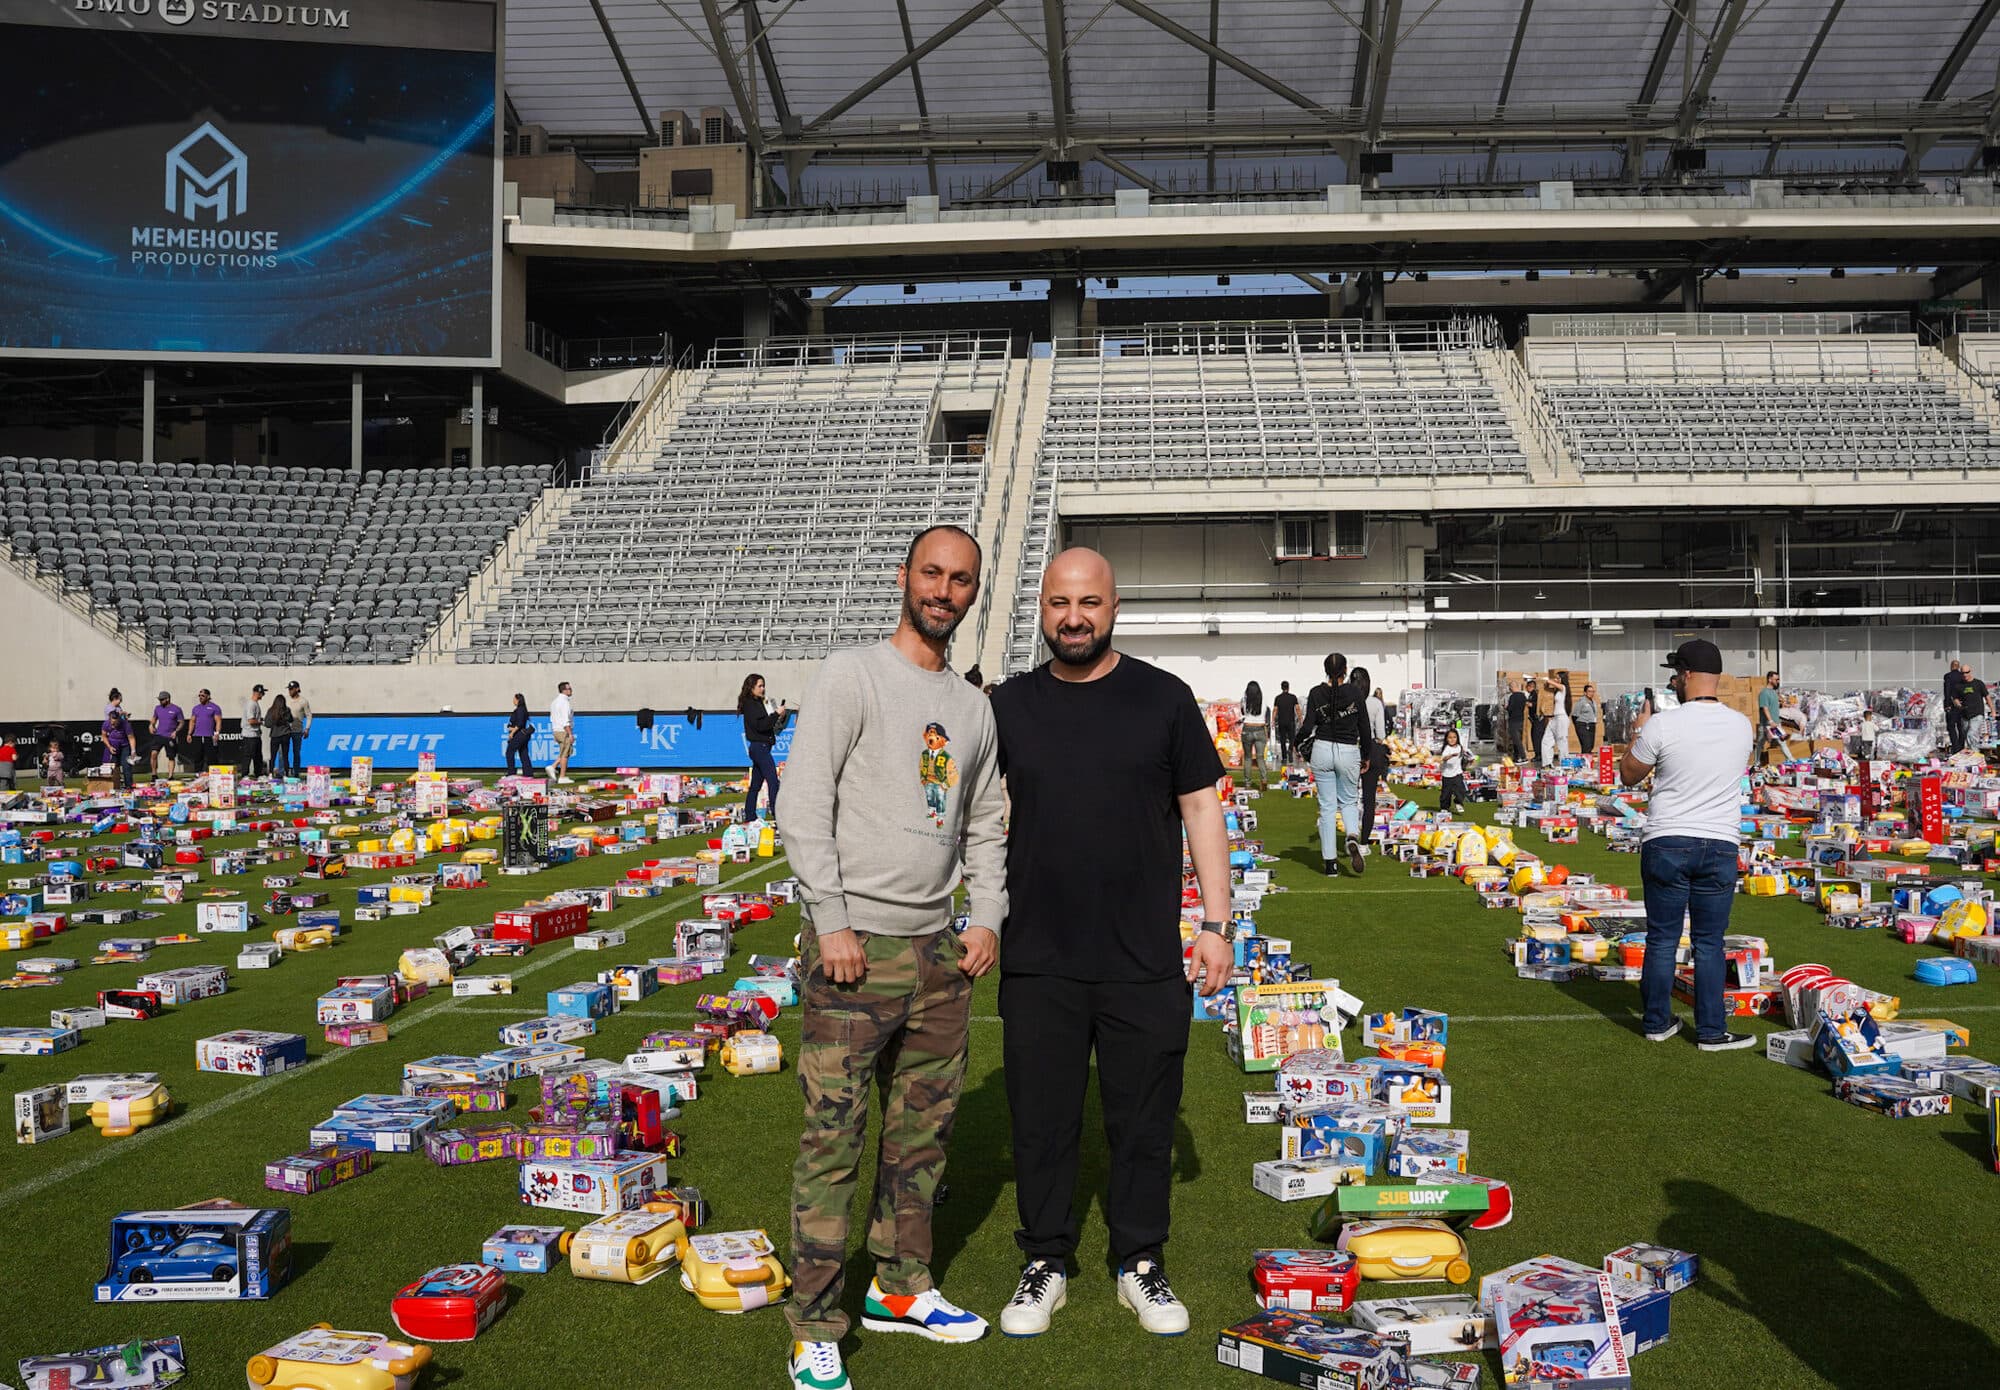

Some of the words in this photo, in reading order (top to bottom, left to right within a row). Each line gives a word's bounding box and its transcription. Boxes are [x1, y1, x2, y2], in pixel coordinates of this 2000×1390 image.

[202, 0, 350, 28] STADIUM
[132, 226, 279, 251] MEMEHOUSE
[131, 251, 278, 268] PRODUCTIONS
[327, 733, 446, 752] RITFIT
[548, 911, 582, 926] TYSON
[1376, 1190, 1449, 1206] SUBWAY
[1609, 1325, 1629, 1375] TRANSFORMERS
